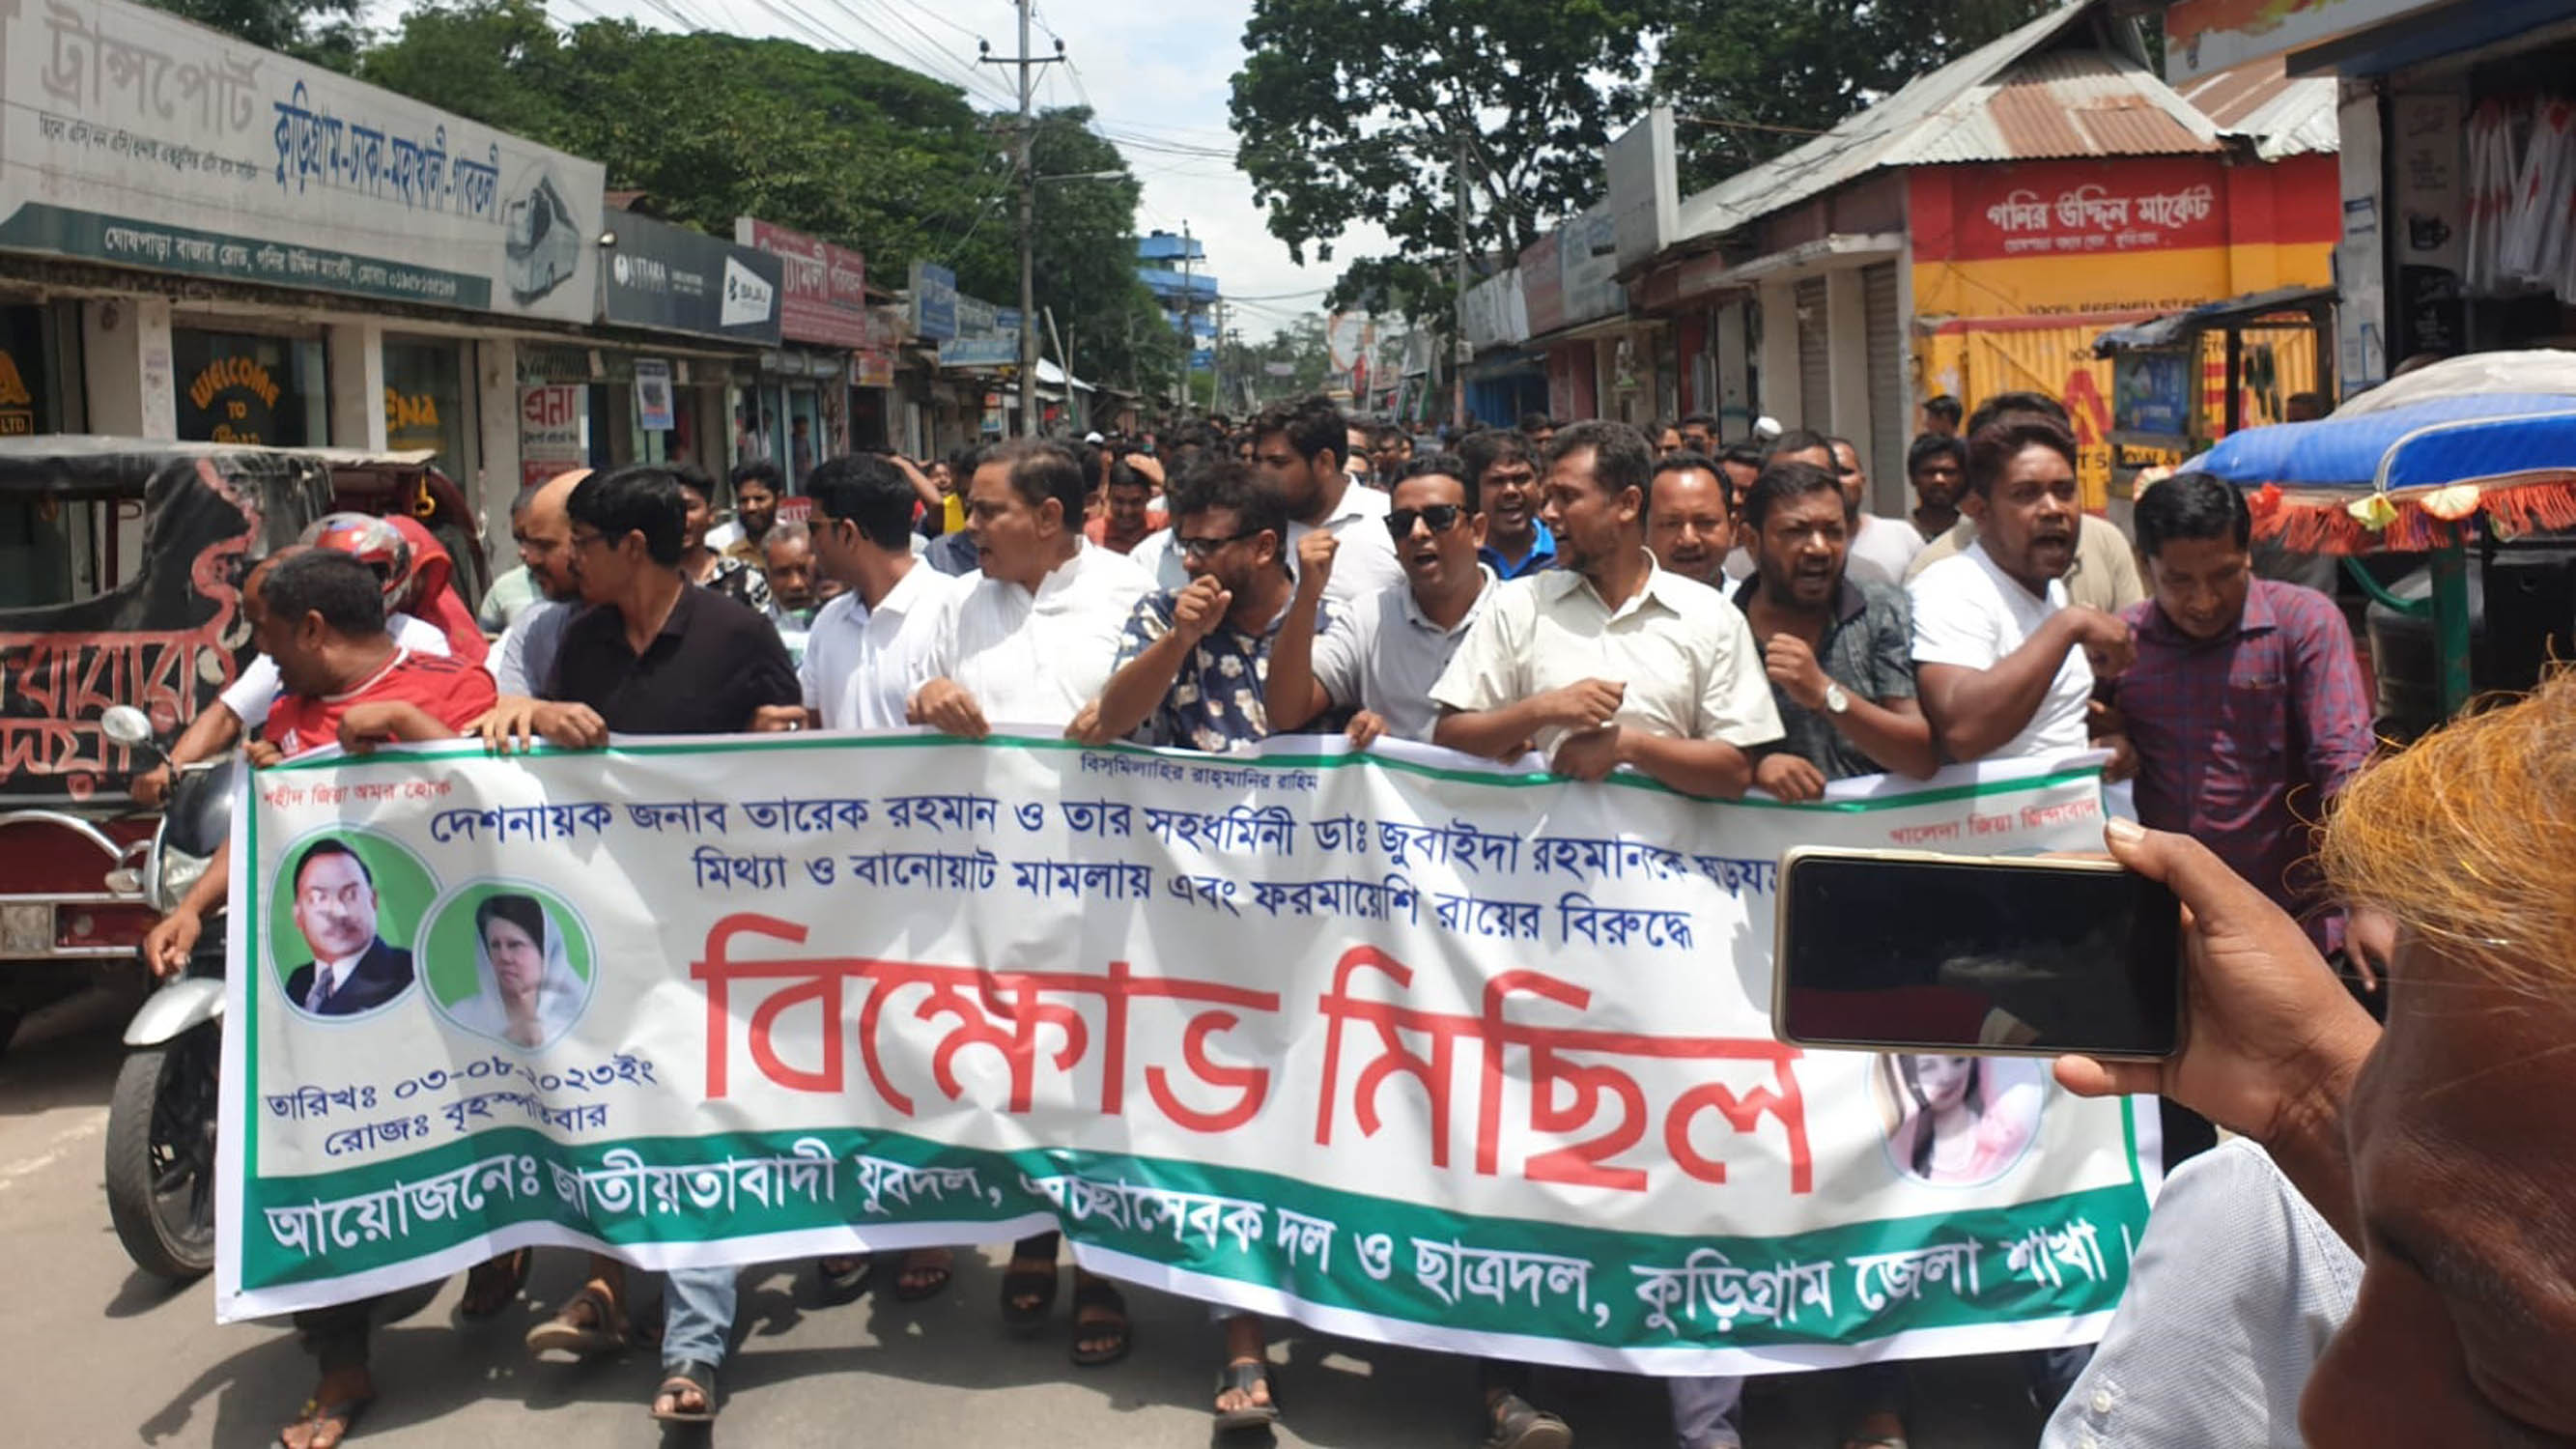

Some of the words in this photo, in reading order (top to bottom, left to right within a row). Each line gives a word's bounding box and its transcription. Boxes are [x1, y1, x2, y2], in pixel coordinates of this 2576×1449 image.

[1986, 189, 2050, 231] গনির
[2054, 184, 2130, 231] উদ্দিন
[2136, 183, 2215, 229] মার্কেট
[175, 238, 215, 264] বাজার
[189, 355, 280, 410] WELCOME
[227, 400, 246, 419] TO
[524, 386, 577, 426] এনা
[263, 783, 302, 809] শহীদ
[312, 782, 349, 805] জিয়া
[354, 782, 396, 802] অমর
[404, 780, 453, 800] হোক
[1277, 769, 1318, 791] রাহিম
[431, 802, 613, 842] দেশনায়ক
[626, 798, 727, 834] জনাব
[740, 797, 869, 834] তারেক
[883, 793, 1001, 834] রহমান
[1014, 803, 1044, 831] ও
[1060, 798, 1133, 838] তার
[1143, 806, 1297, 856] সহধর্মিনী
[1310, 813, 1368, 854] ডাঃ
[1376, 818, 1521, 873] জুবাইদা
[691, 845, 787, 889] মিথ্যা
[806, 857, 835, 886] ও
[849, 846, 1001, 893] বানোয়াট
[1010, 858, 1154, 899] মামলায়
[1168, 873, 1240, 917] এবং
[1251, 873, 1421, 925] ফরমায়েশি
[1434, 892, 1543, 941] রায়ের
[1554, 892, 1694, 949] বিরুদ্ধে
[690, 912, 1280, 1134] বিক্ষোভ
[1315, 944, 1813, 1194] মিছিল
[266, 1084, 378, 1122] তারিখঃ
[325, 1113, 430, 1157] রোজঃ
[263, 1153, 541, 1257] আয়োজনেঃ
[547, 1137, 840, 1220] জাতীয়তাবাদী
[856, 1154, 1003, 1216] যুবদল,
[1276, 1207, 1338, 1274] দল
[1354, 1233, 1393, 1281] ও
[1410, 1237, 1611, 1330] ছাত্রদল,
[1629, 1247, 1834, 1337] কুড়িগ্রাম
[1848, 1235, 1984, 1312] জেলা
[1998, 1217, 2107, 1289] শাখা
